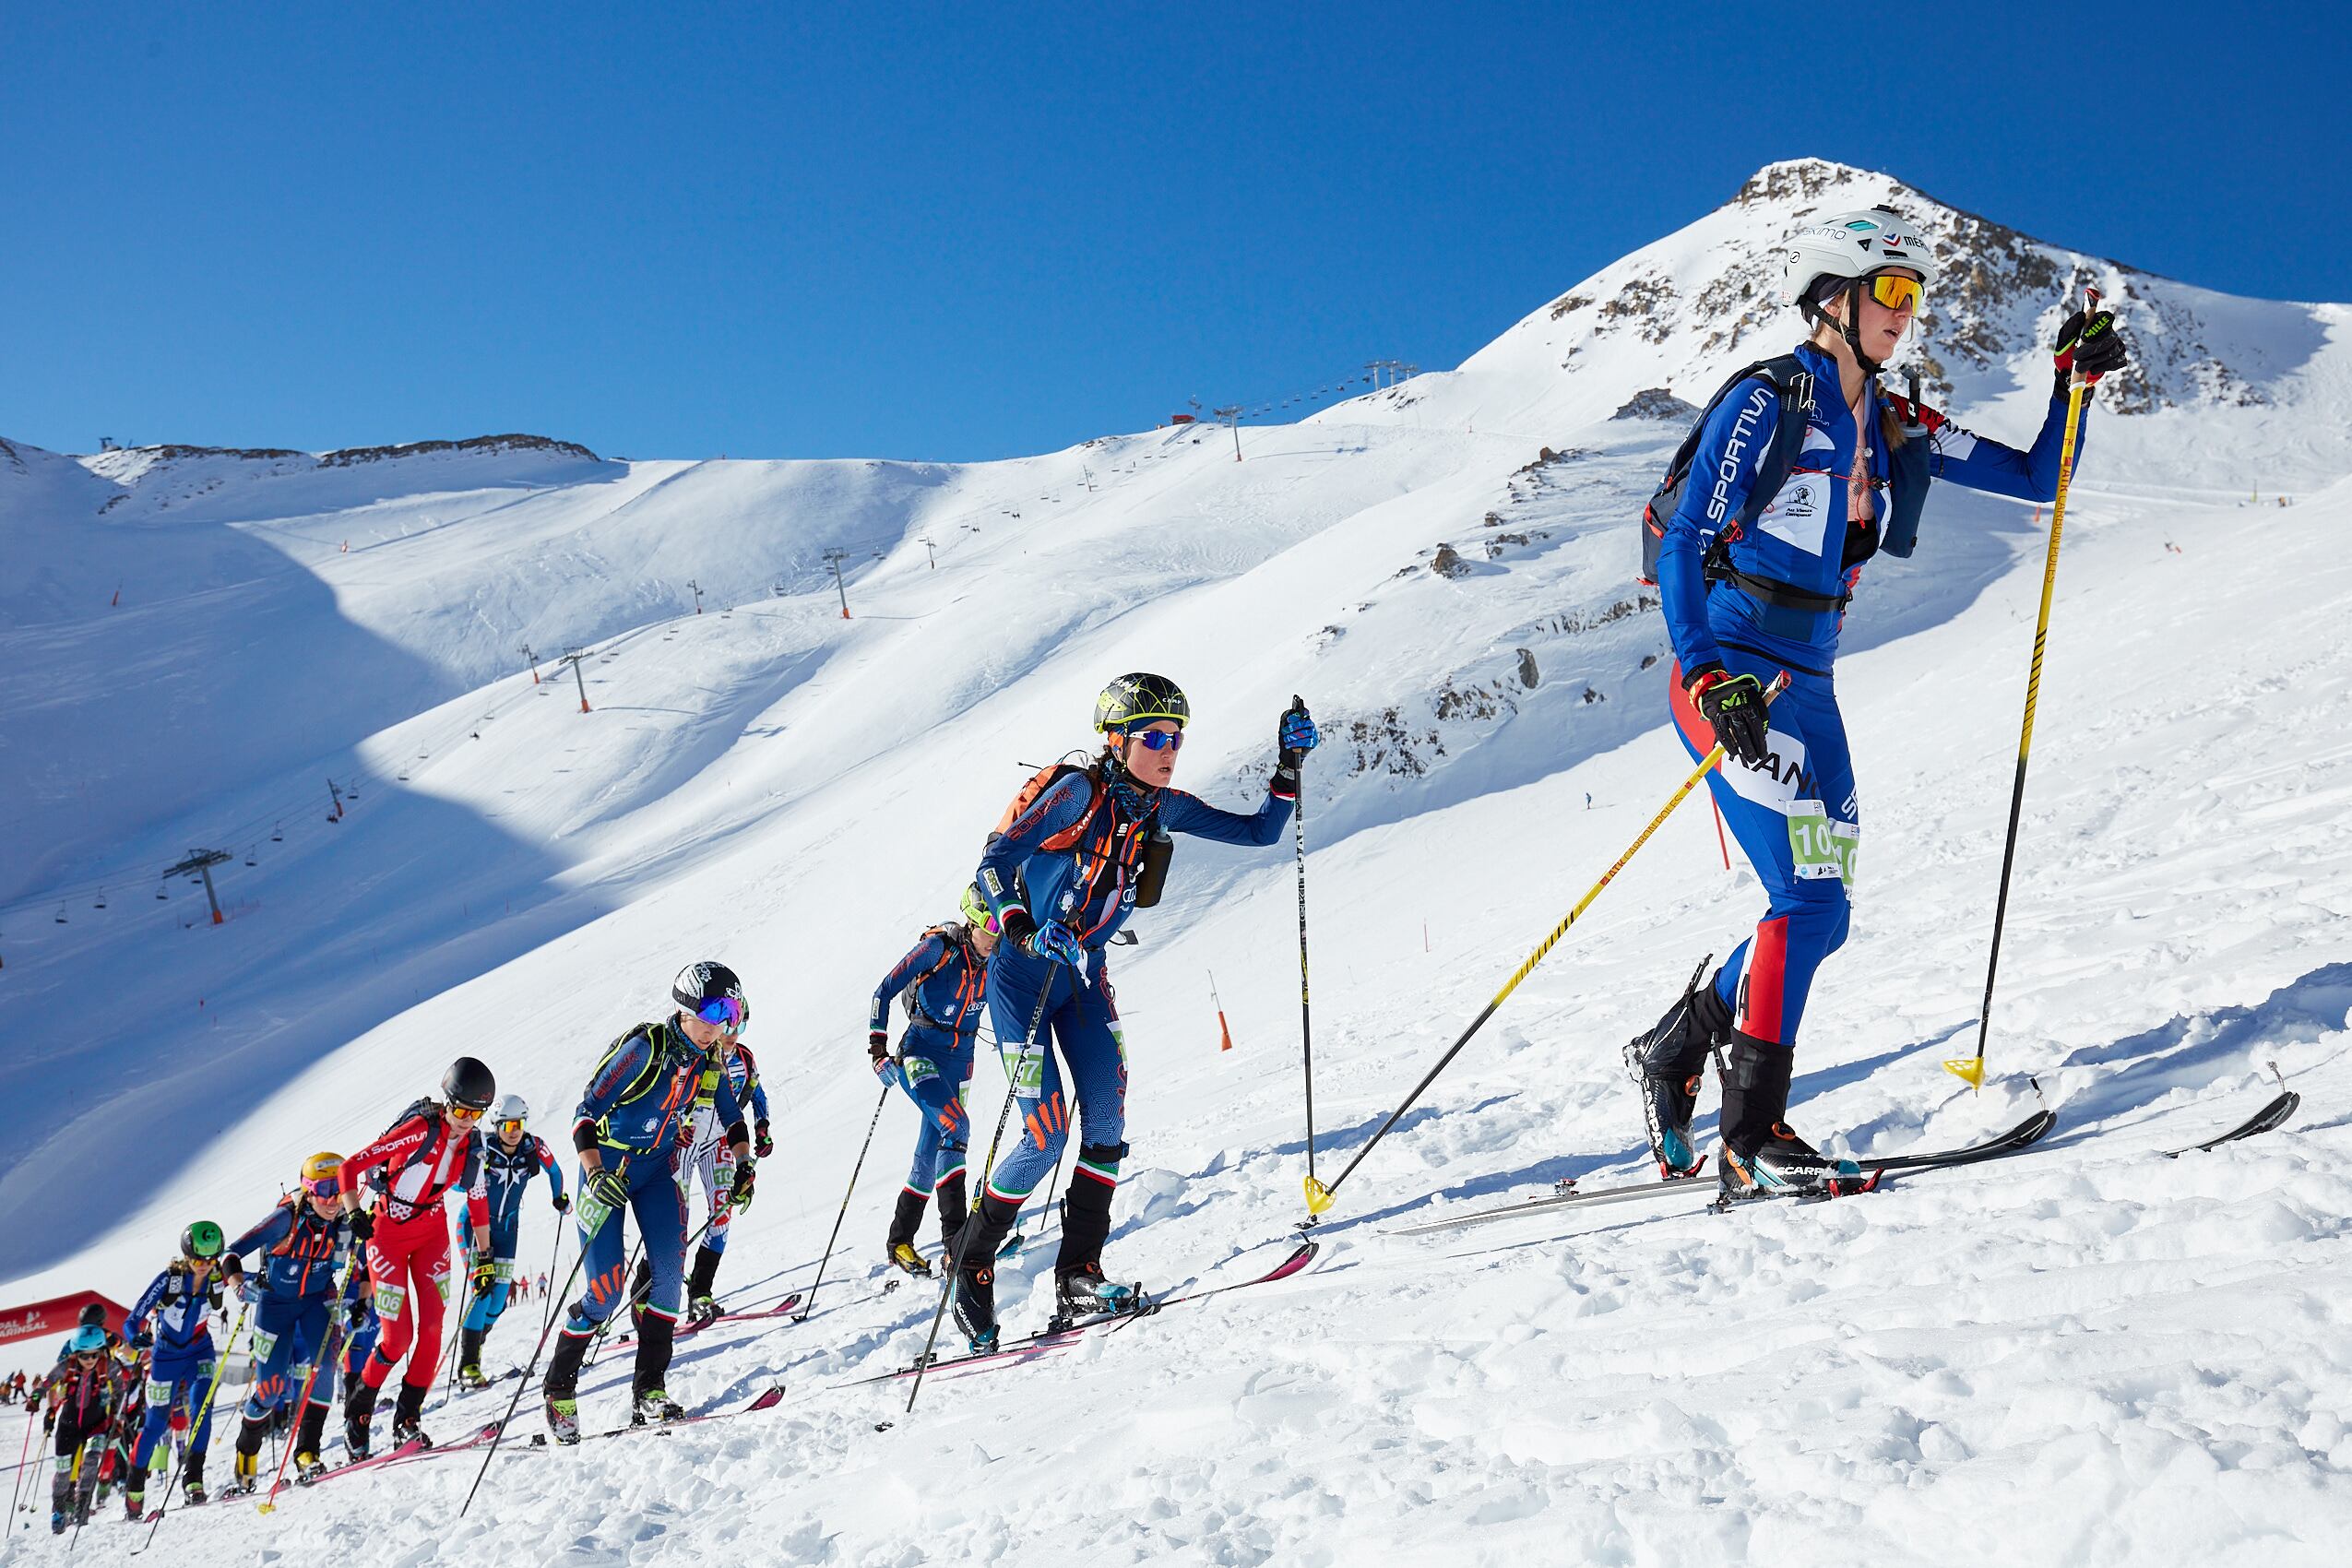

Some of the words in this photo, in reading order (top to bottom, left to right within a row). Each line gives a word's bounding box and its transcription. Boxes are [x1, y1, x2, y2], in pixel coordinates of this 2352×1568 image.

[1706, 387, 1775, 524] SPORTIVA
[1071, 810, 1093, 837] CAMP
[366, 1244, 396, 1279] SUI
[376, 1291, 400, 1311] 106
[955, 1301, 977, 1337] SCARPA
